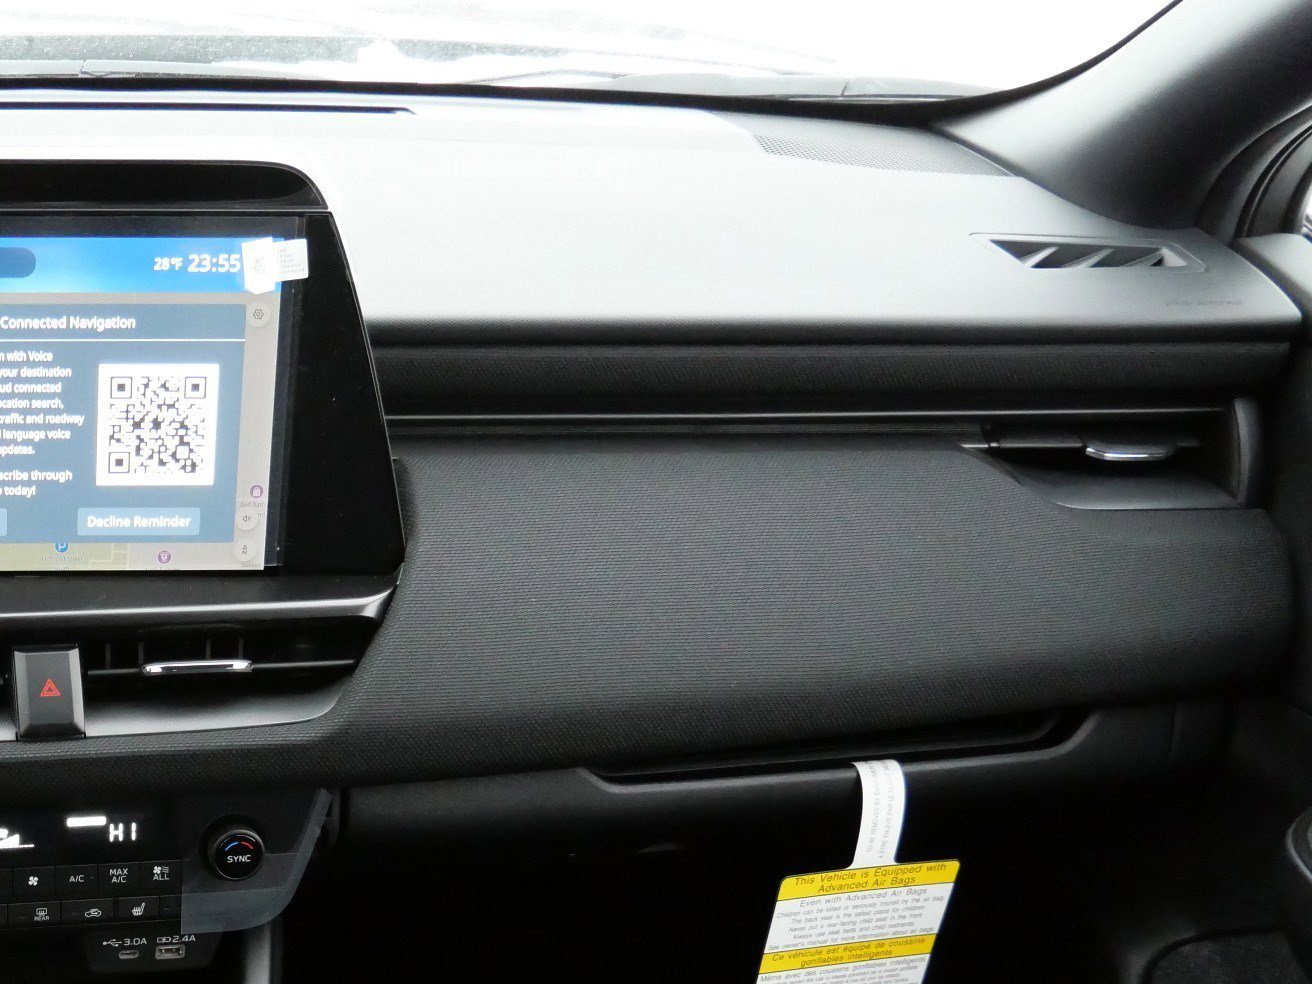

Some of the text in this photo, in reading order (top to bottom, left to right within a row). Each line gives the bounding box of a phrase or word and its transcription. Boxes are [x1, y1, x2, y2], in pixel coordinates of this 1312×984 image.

[188, 253, 241, 273] 23:55
[0, 315, 66, 330] Connected
[69, 315, 136, 332] Navigation
[7, 350, 26, 362] with
[28, 350, 53, 361] Voice
[20, 366, 72, 378] destination
[14, 382, 62, 393] connected
[31, 397, 64, 410] search,
[25, 413, 44, 424] and
[45, 413, 85, 427] roadway
[3, 428, 45, 442] language
[46, 428, 71, 439] voice
[30, 470, 73, 483] through
[4, 485, 36, 498] today!
[86, 515, 192, 529] Decline Reminder
[109, 822, 137, 842] HI
[227, 855, 251, 863] SYNC
[109, 868, 128, 876] MAX
[795, 877, 814, 886] This
[820, 872, 856, 882] Vehicle
[874, 865, 923, 877] Equipped
[926, 863, 947, 872] with
[69, 875, 85, 883] A/C
[817, 877, 916, 893] Advanced Air Bags
[800, 899, 821, 907] Even
[825, 896, 841, 904] with
[845, 891, 887, 902] Advanced
[906, 888, 928, 896] Bags
[124, 938, 147, 946] 3.0A
[172, 935, 196, 943] 2.4A
[772, 954, 784, 962] Ce
[826, 947, 840, 955] est
[889, 938, 927, 948] coussins
[800, 955, 844, 968] gonflables
